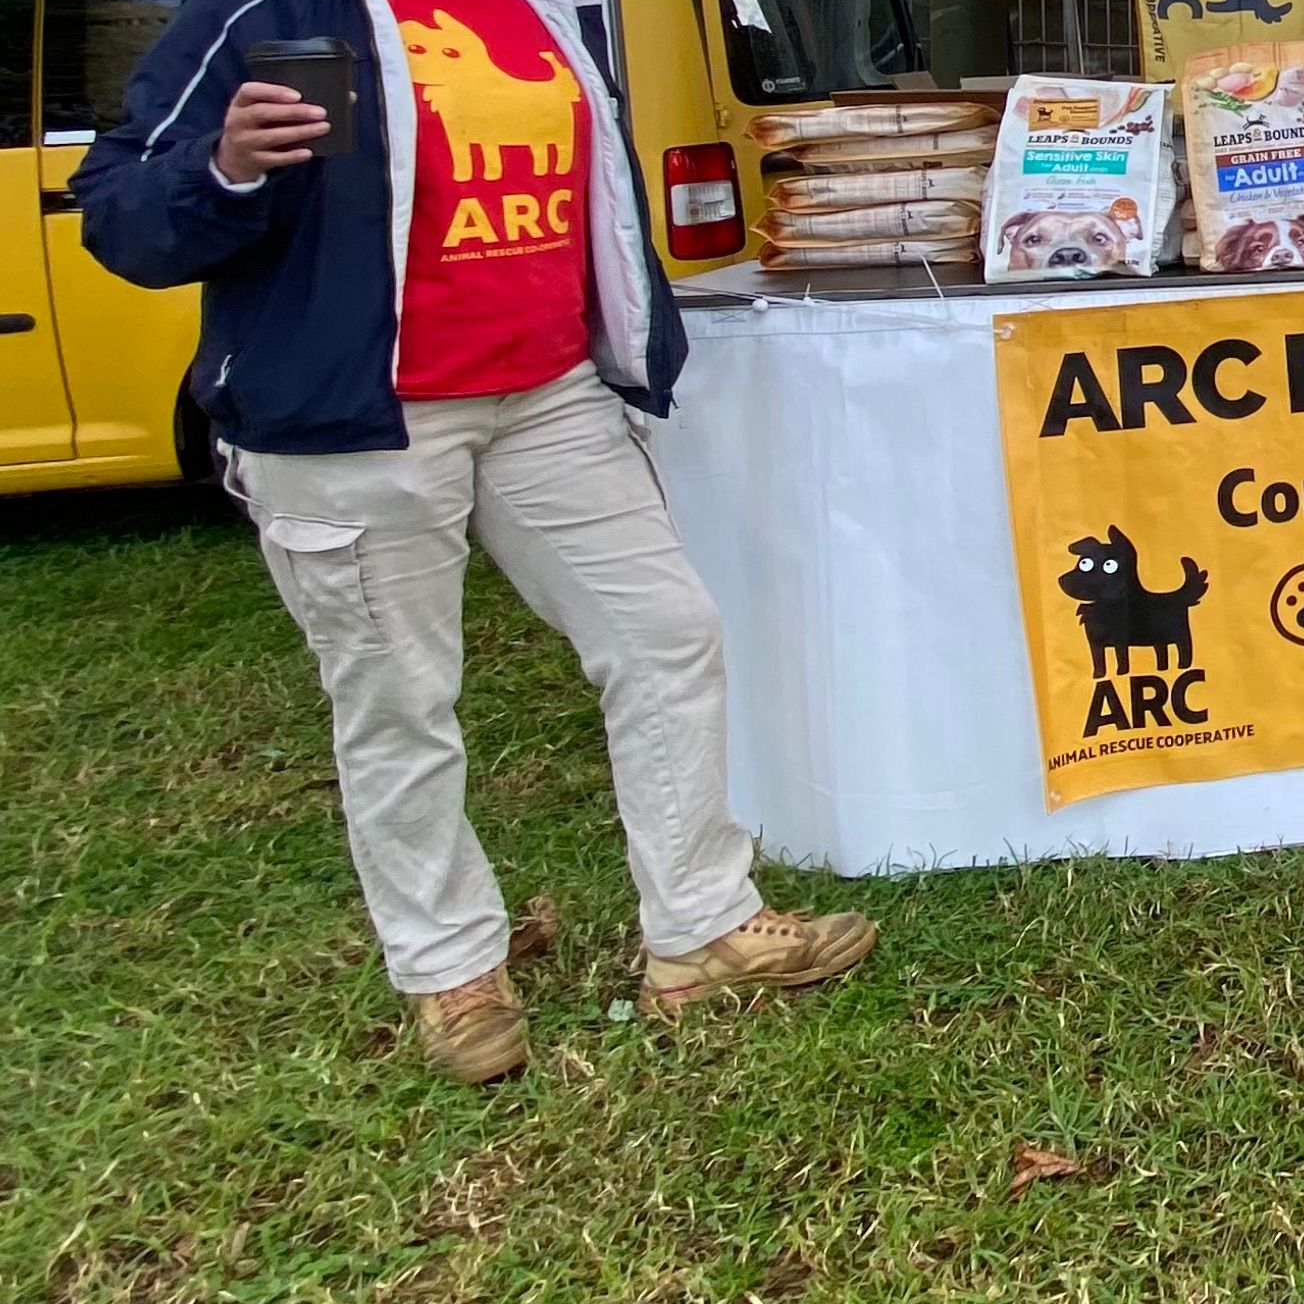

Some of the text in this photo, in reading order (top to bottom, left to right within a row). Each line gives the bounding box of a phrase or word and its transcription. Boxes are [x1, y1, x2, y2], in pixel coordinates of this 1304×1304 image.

[1027, 134, 1069, 144] LEAPS
[1081, 136, 1134, 145] BOUNDS
[1213, 133, 1252, 147] LEAPS
[1026, 151, 1125, 162] Sensitive Skin
[1231, 149, 1301, 164] GRAIN FREE
[1051, 163, 1089, 172] Adult
[1233, 162, 1298, 188] Adult
[442, 189, 573, 248] ARC
[440, 251, 484, 263] ANIMAL
[486, 247, 524, 257] RESCUE
[1039, 339, 1267, 438] ARC
[1082, 669, 1209, 739] ARC
[1099, 737, 1154, 757] RESCUE
[1156, 724, 1255, 748] COOPERATIVE
